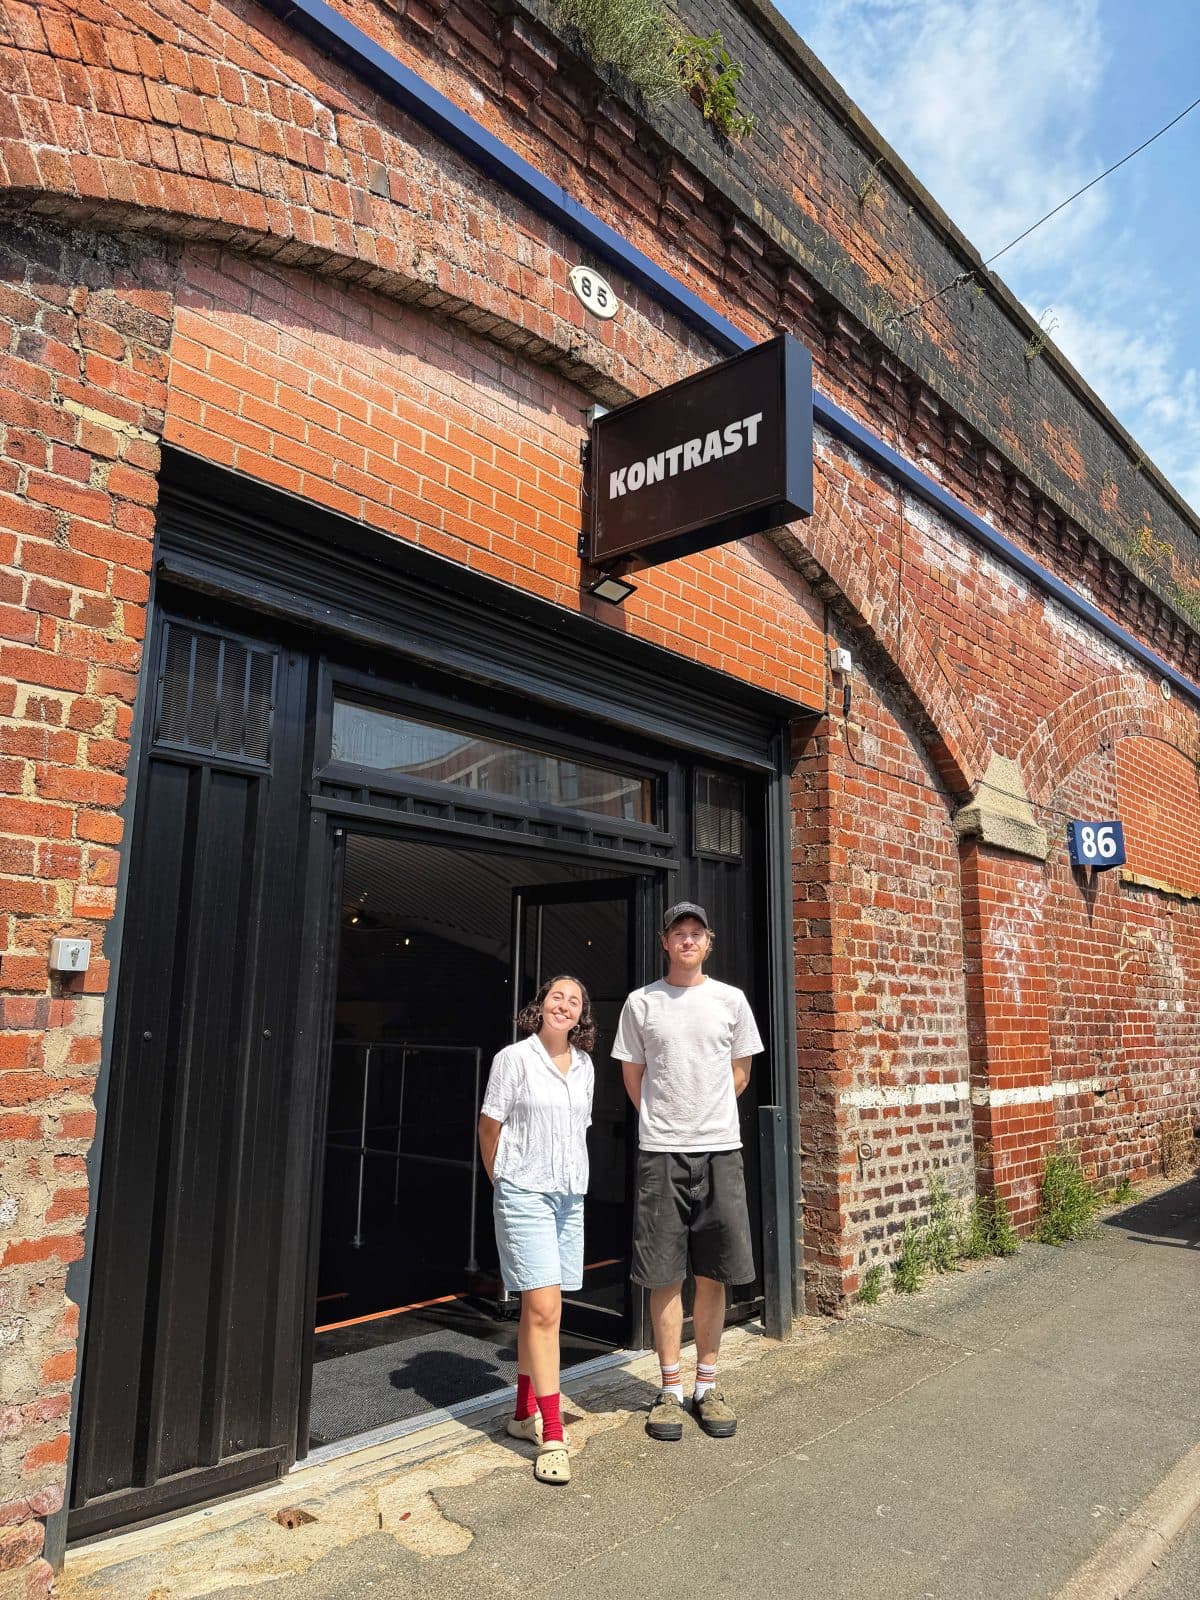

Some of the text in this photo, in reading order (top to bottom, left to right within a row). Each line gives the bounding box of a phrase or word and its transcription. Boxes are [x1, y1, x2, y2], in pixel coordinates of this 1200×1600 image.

[581, 276, 607, 308] 85
[609, 412, 762, 499] KONTRAST
[1081, 826, 1117, 858] 86
